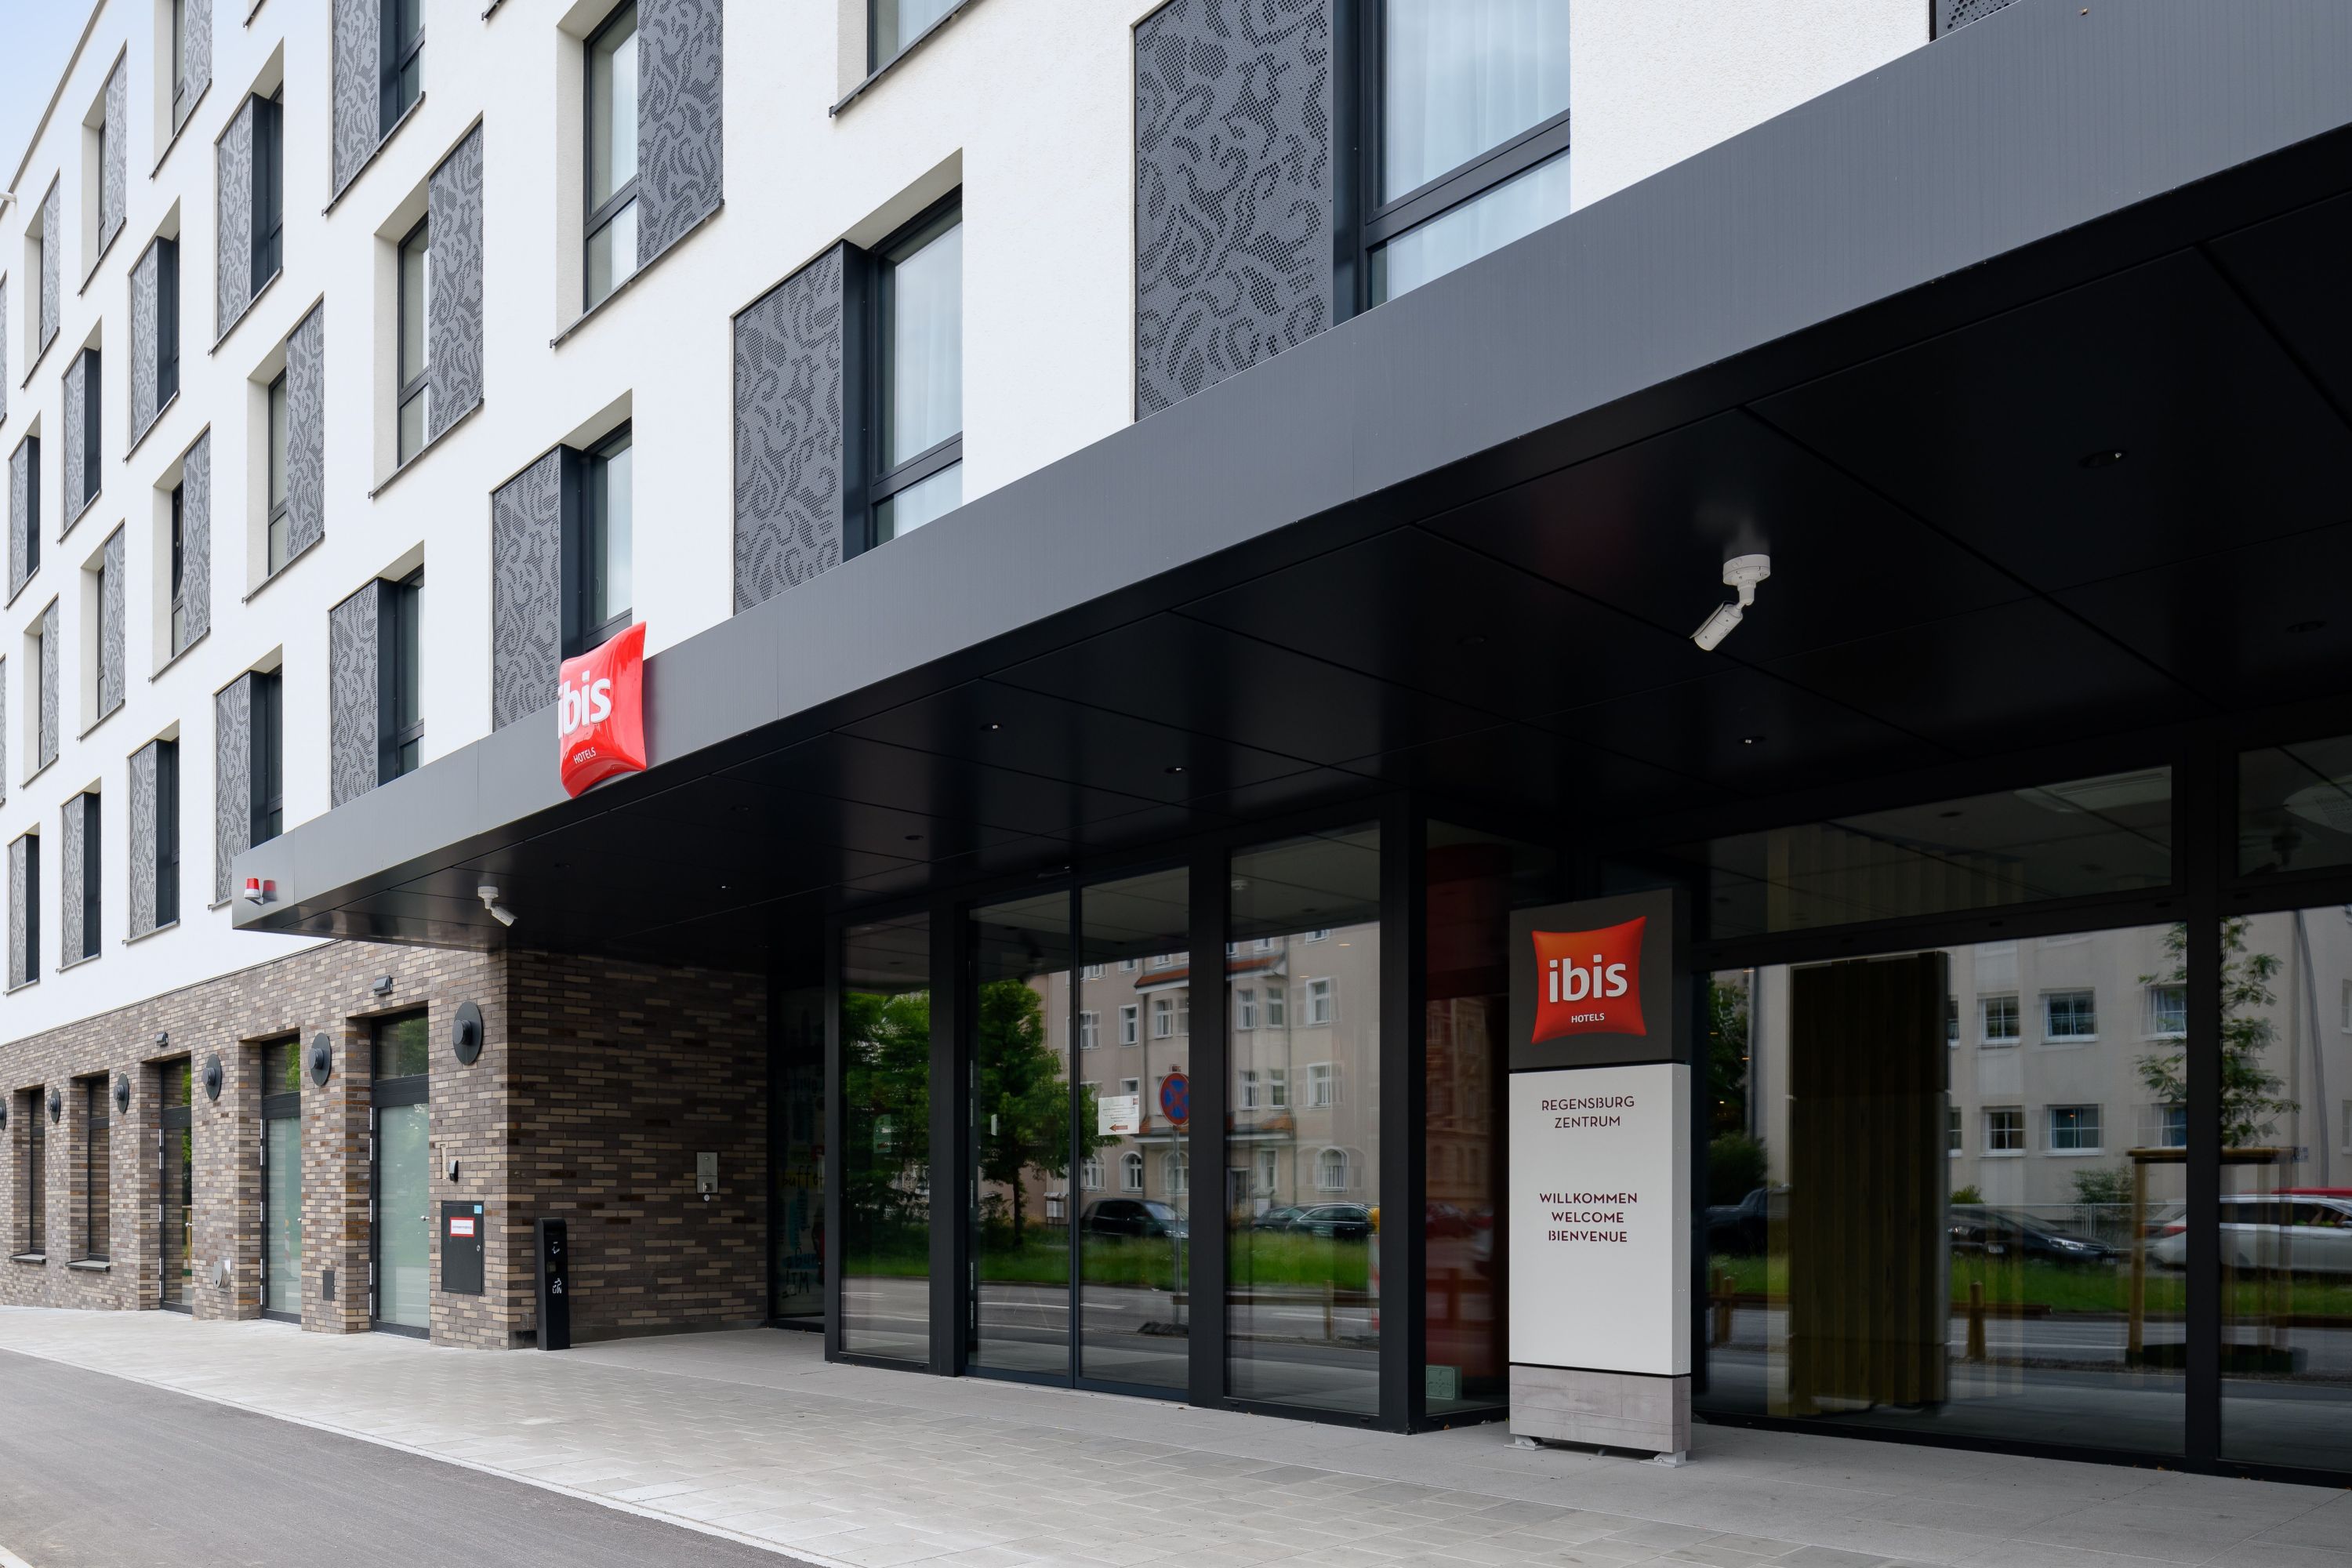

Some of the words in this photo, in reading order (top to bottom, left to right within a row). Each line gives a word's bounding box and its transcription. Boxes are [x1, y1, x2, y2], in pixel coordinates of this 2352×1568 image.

[557, 670, 612, 739] ibis
[573, 746, 597, 765] HOTELS
[1549, 954, 1628, 1003] ibis
[1571, 1012, 1605, 1023] HOTELS
[1541, 1095, 1635, 1111] REGENSBURG
[1555, 1116, 1621, 1129] ZENTRUM
[1539, 1192, 1638, 1204] WILLKOMMEN
[1552, 1211, 1624, 1223] WELCOME
[1548, 1230, 1628, 1243] BIENVENUE
